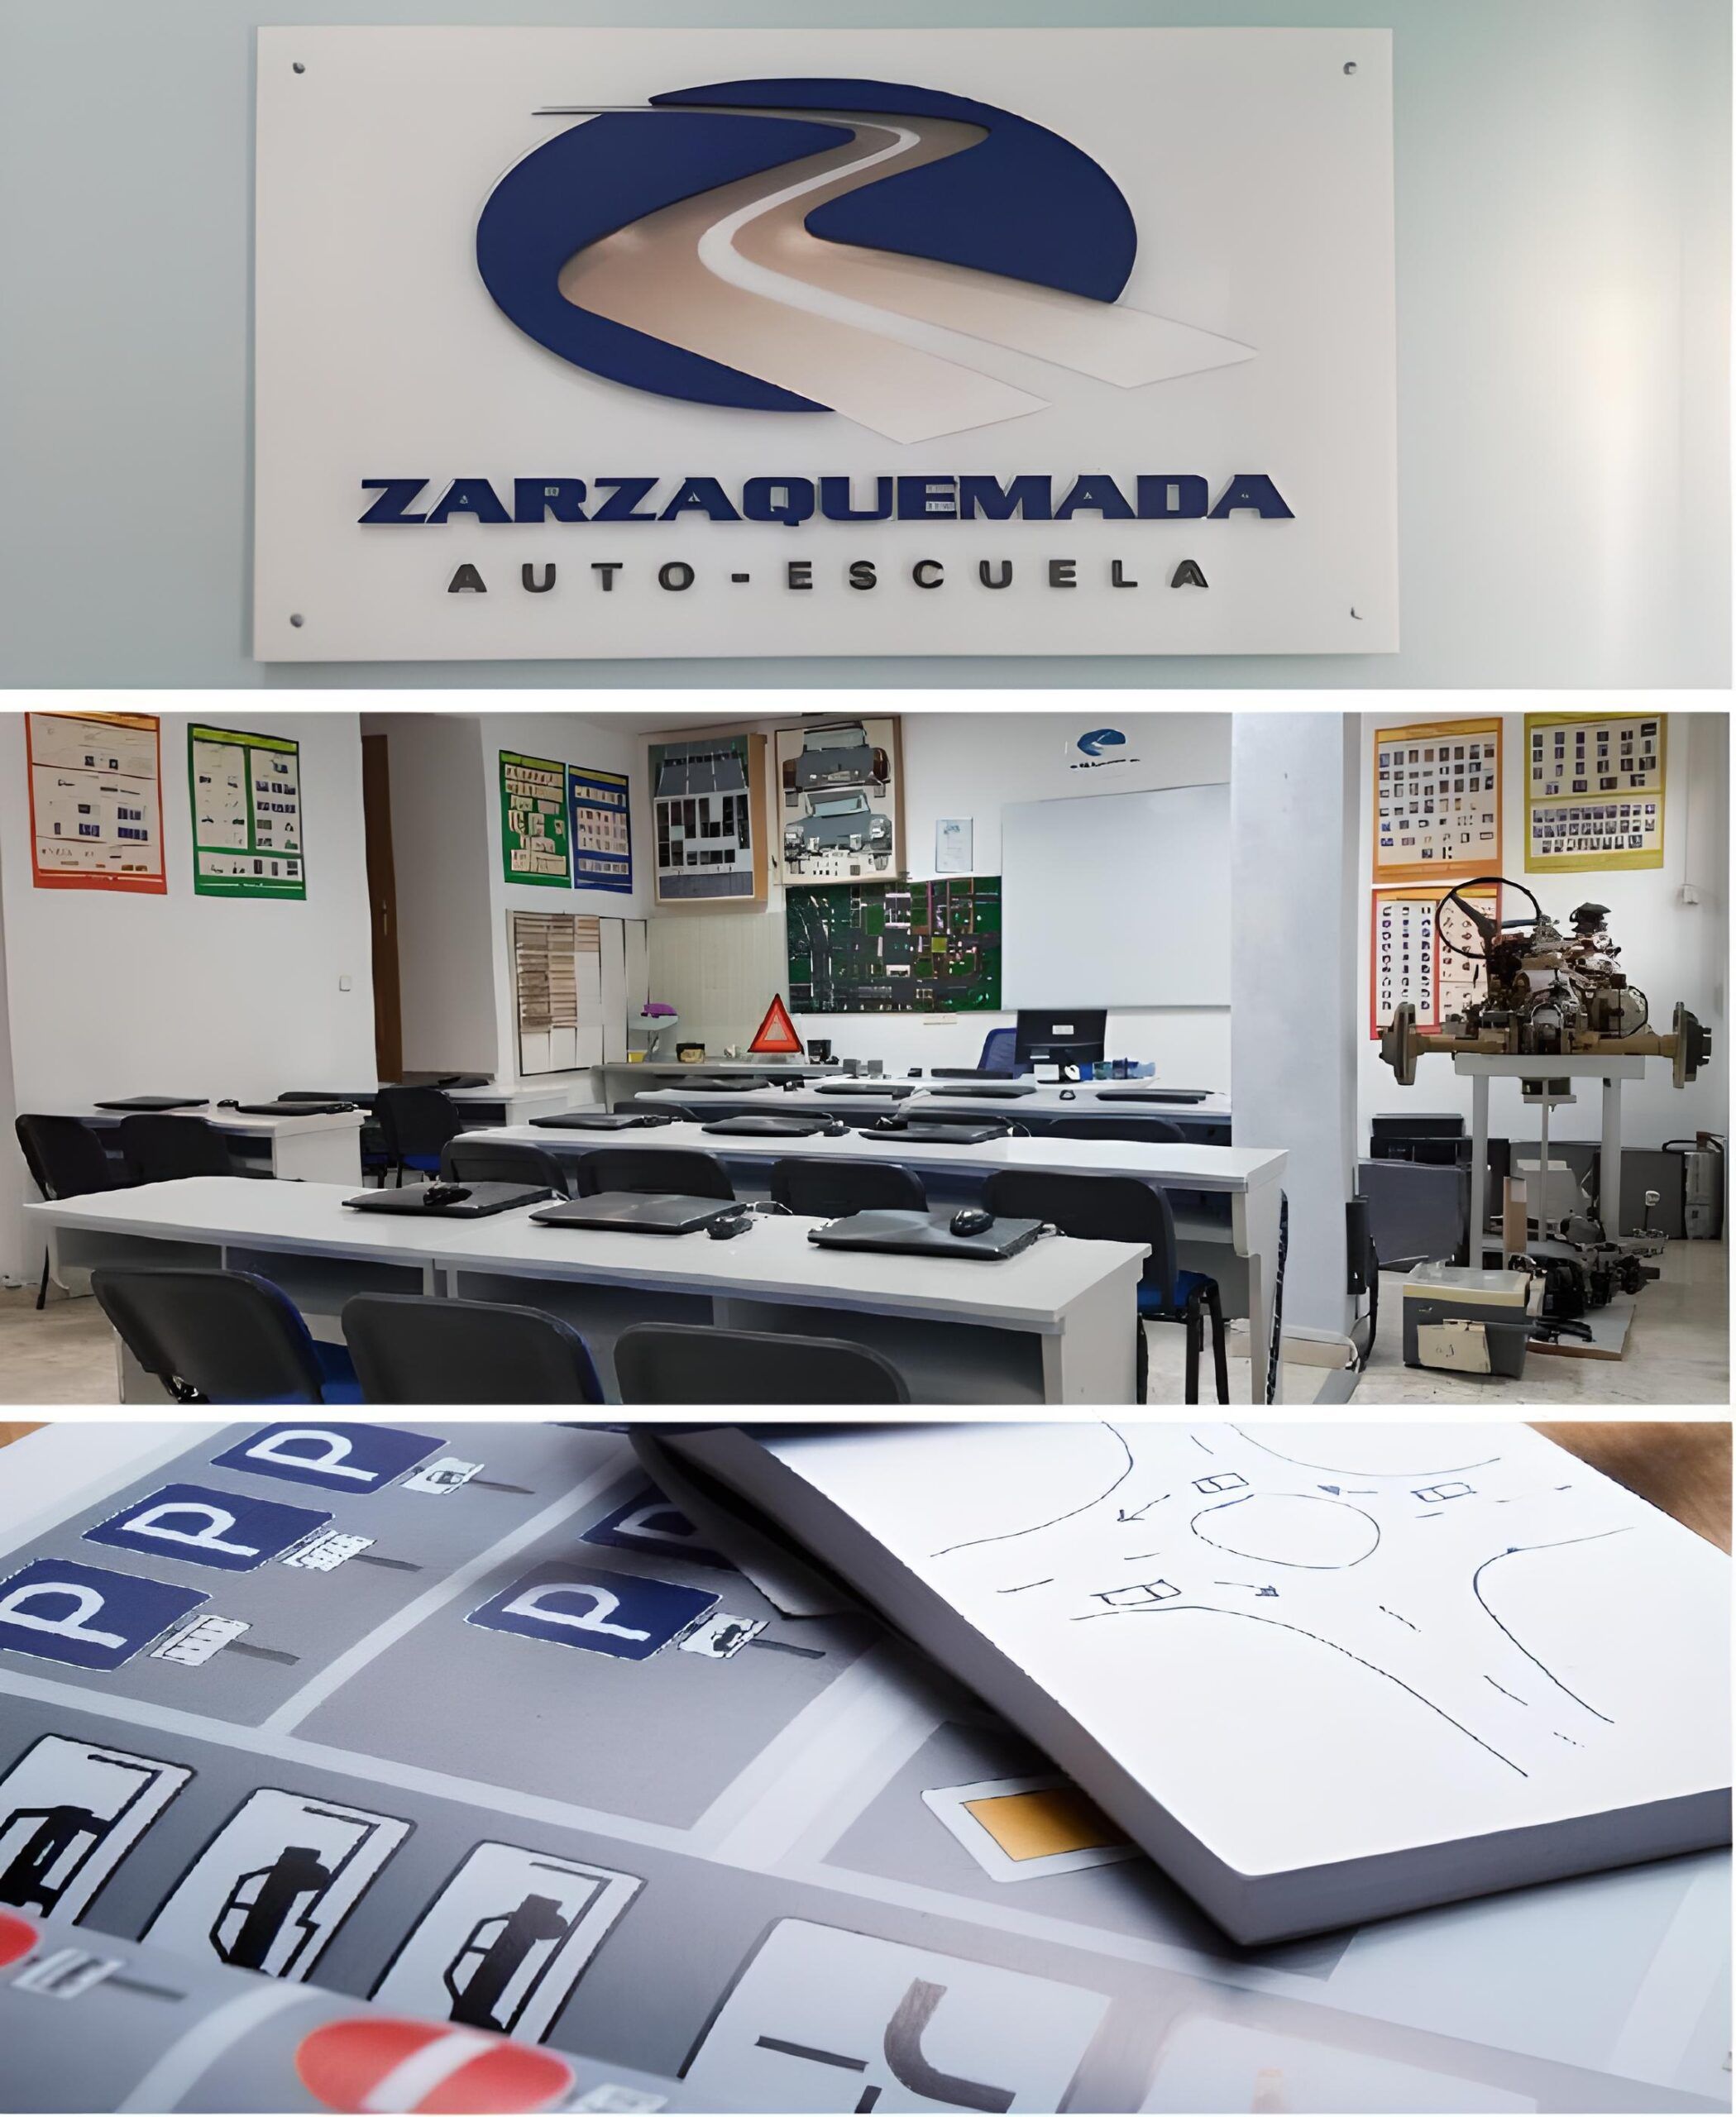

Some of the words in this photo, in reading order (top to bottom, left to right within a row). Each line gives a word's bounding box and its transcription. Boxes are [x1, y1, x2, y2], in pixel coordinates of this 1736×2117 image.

[357, 475, 1295, 527] ZARZAQUEMADA
[246, 1429, 379, 1481] P
[116, 1502, 260, 1555] P
[0, 1581, 127, 1649] P
[502, 1583, 651, 1642] P
